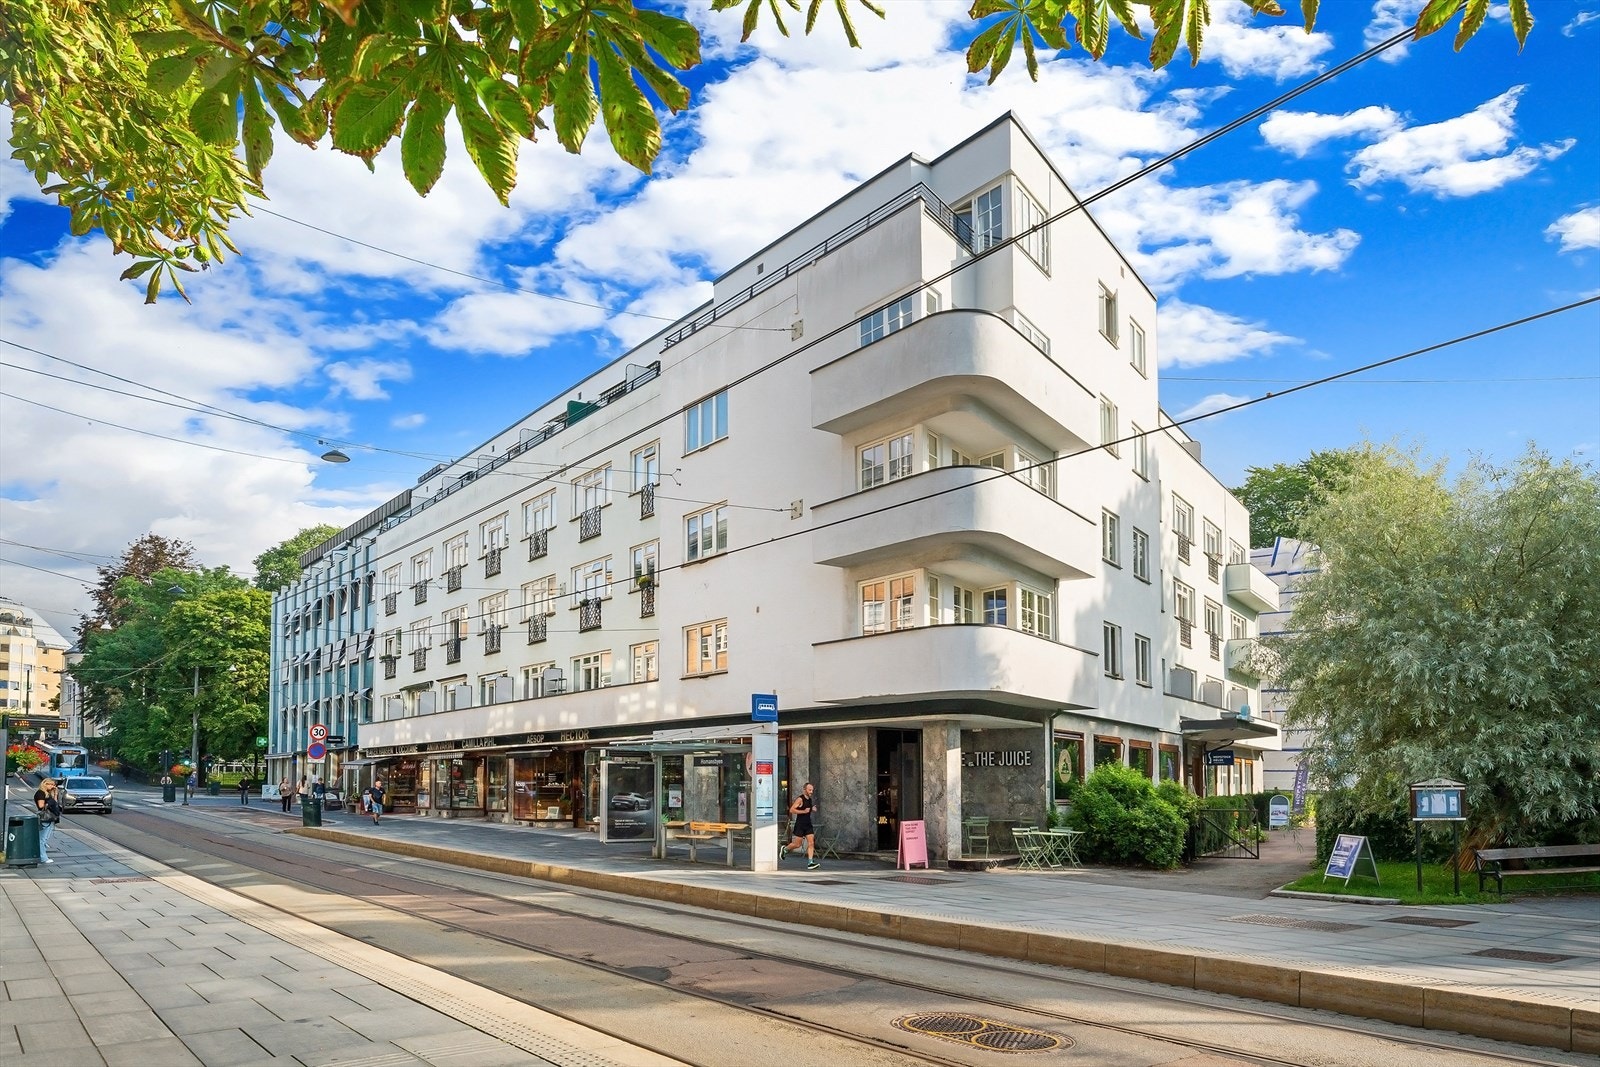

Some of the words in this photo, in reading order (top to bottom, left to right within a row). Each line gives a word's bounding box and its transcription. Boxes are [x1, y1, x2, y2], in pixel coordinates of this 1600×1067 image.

[314, 728, 324, 736] 30
[560, 729, 590, 742] HECTOR
[526, 734, 544, 744] AESOP
[975, 752, 995, 766] THE
[998, 750, 1031, 766] JUICE
